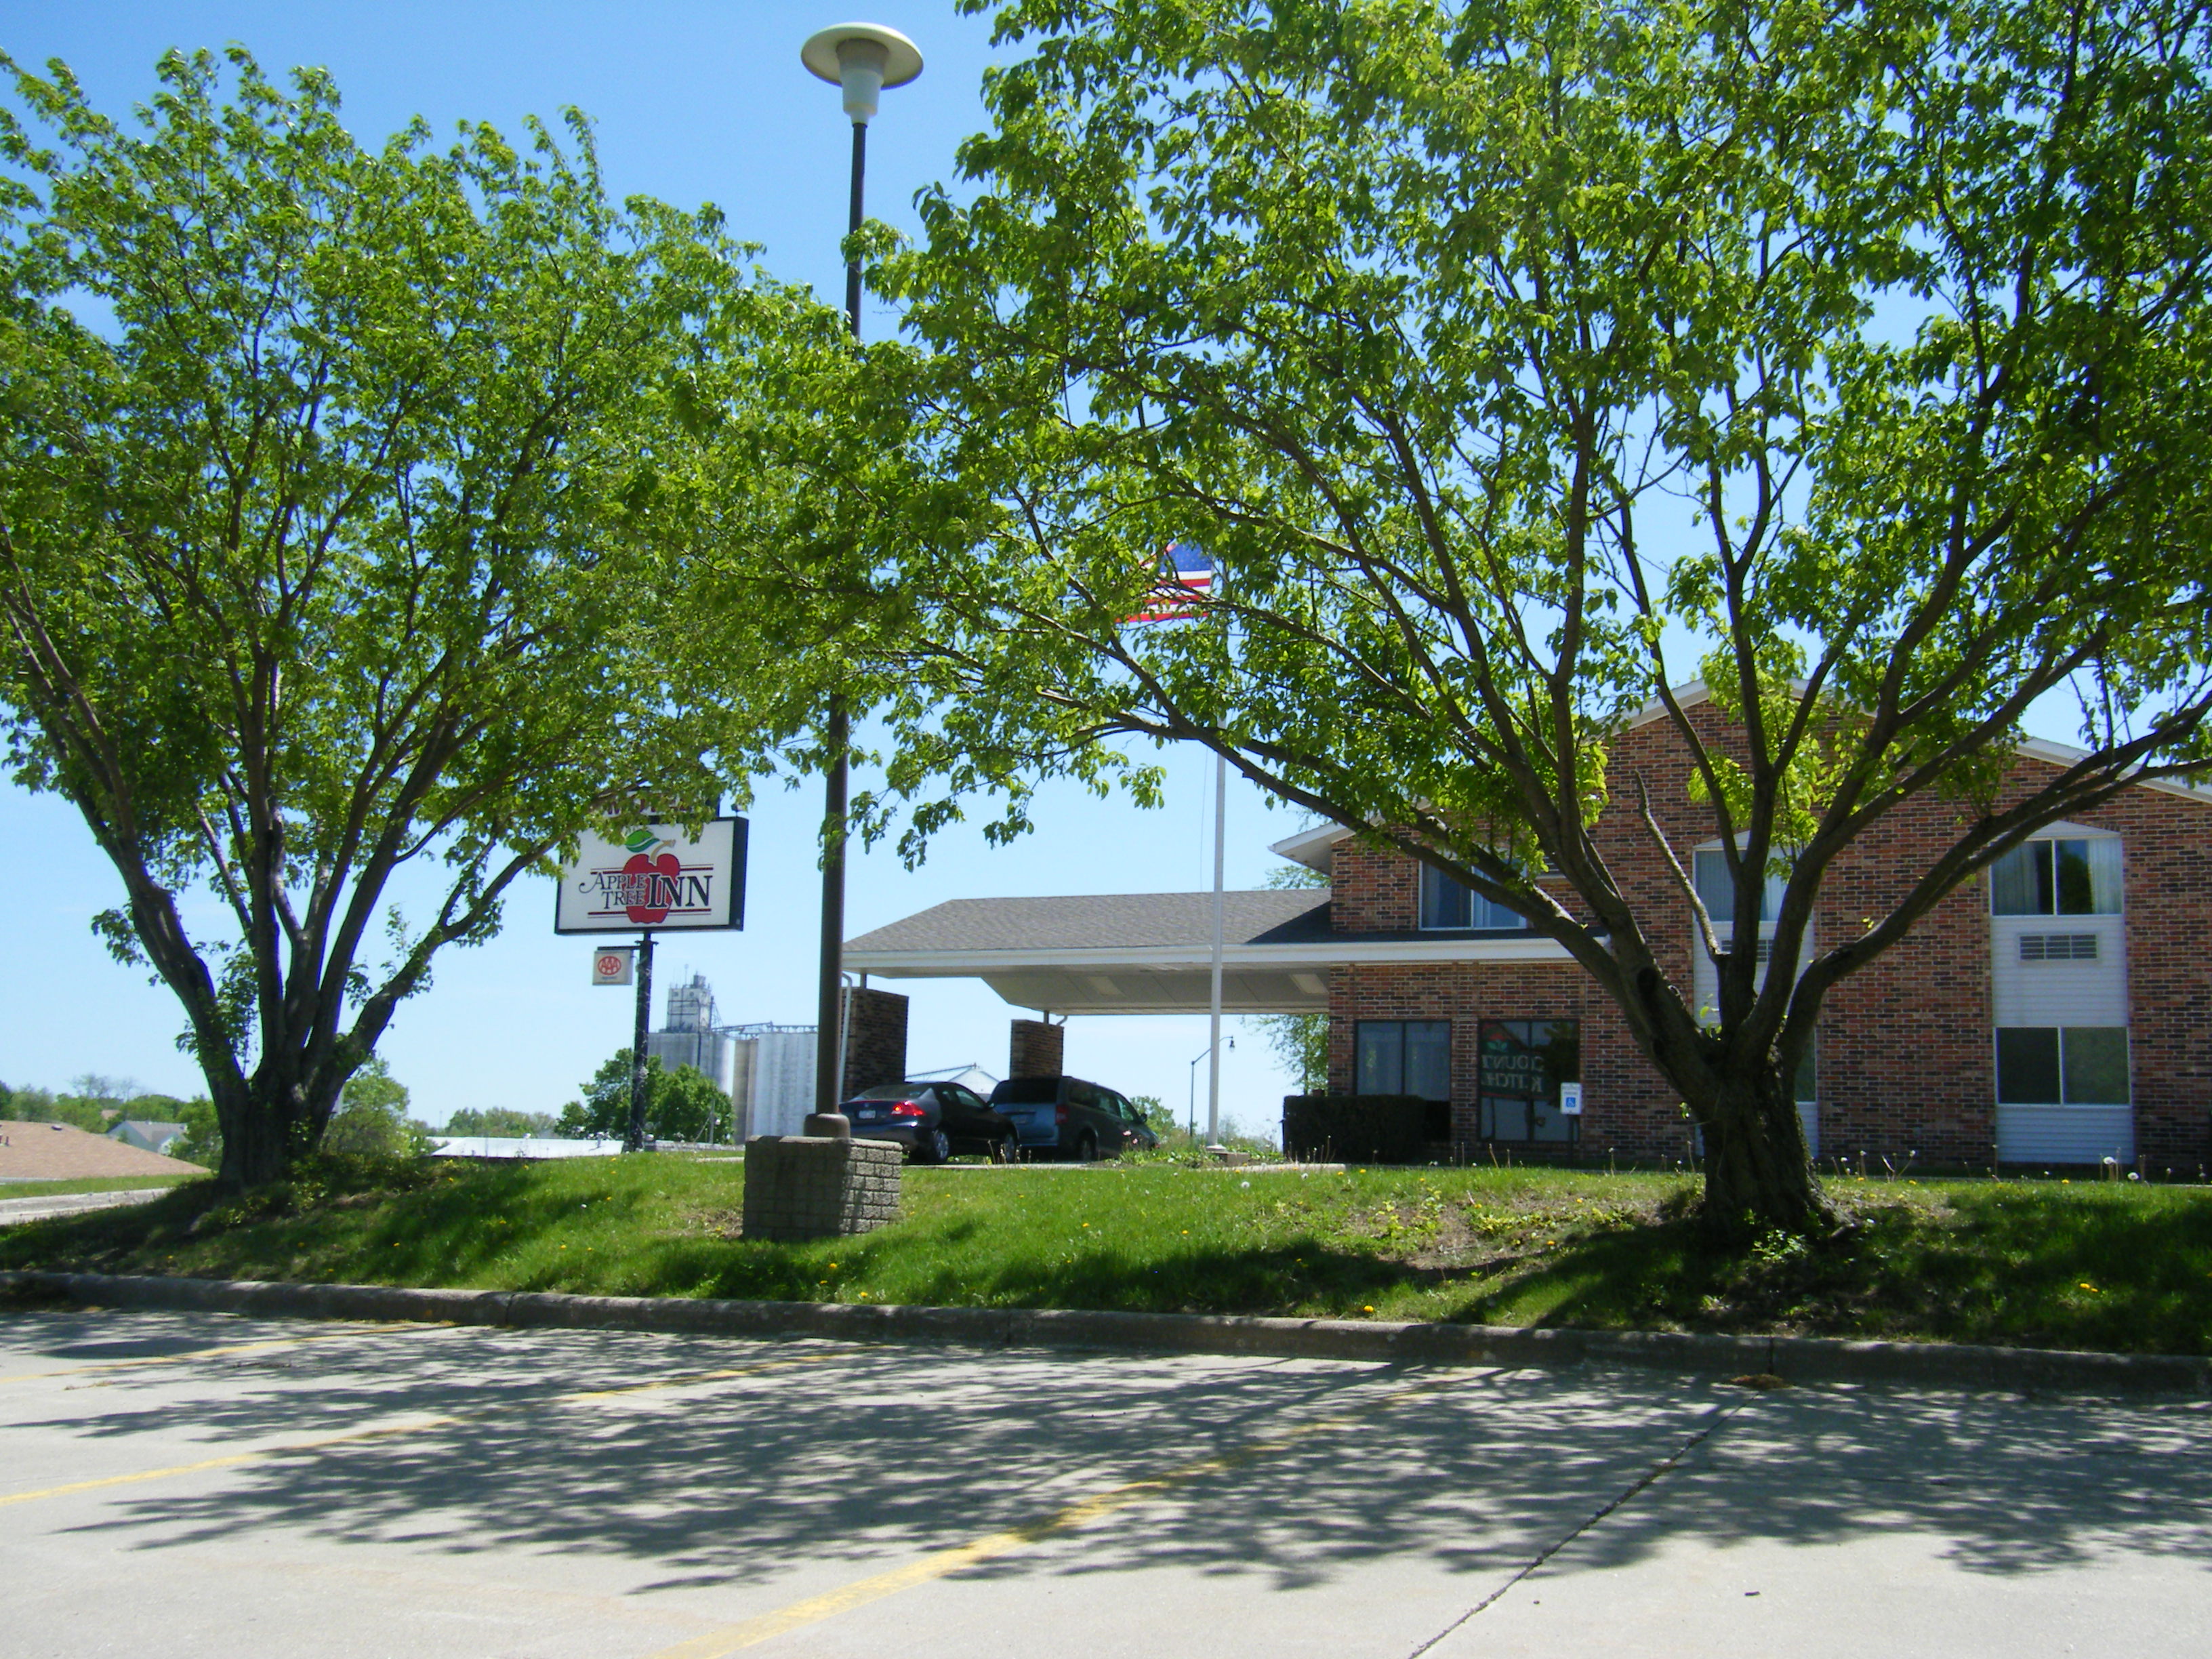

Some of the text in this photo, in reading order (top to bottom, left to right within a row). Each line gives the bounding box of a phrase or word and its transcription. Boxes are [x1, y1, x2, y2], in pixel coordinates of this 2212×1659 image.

[579, 872, 647, 893] APPLE
[647, 874, 713, 907] INN
[601, 890, 645, 909] TREE
